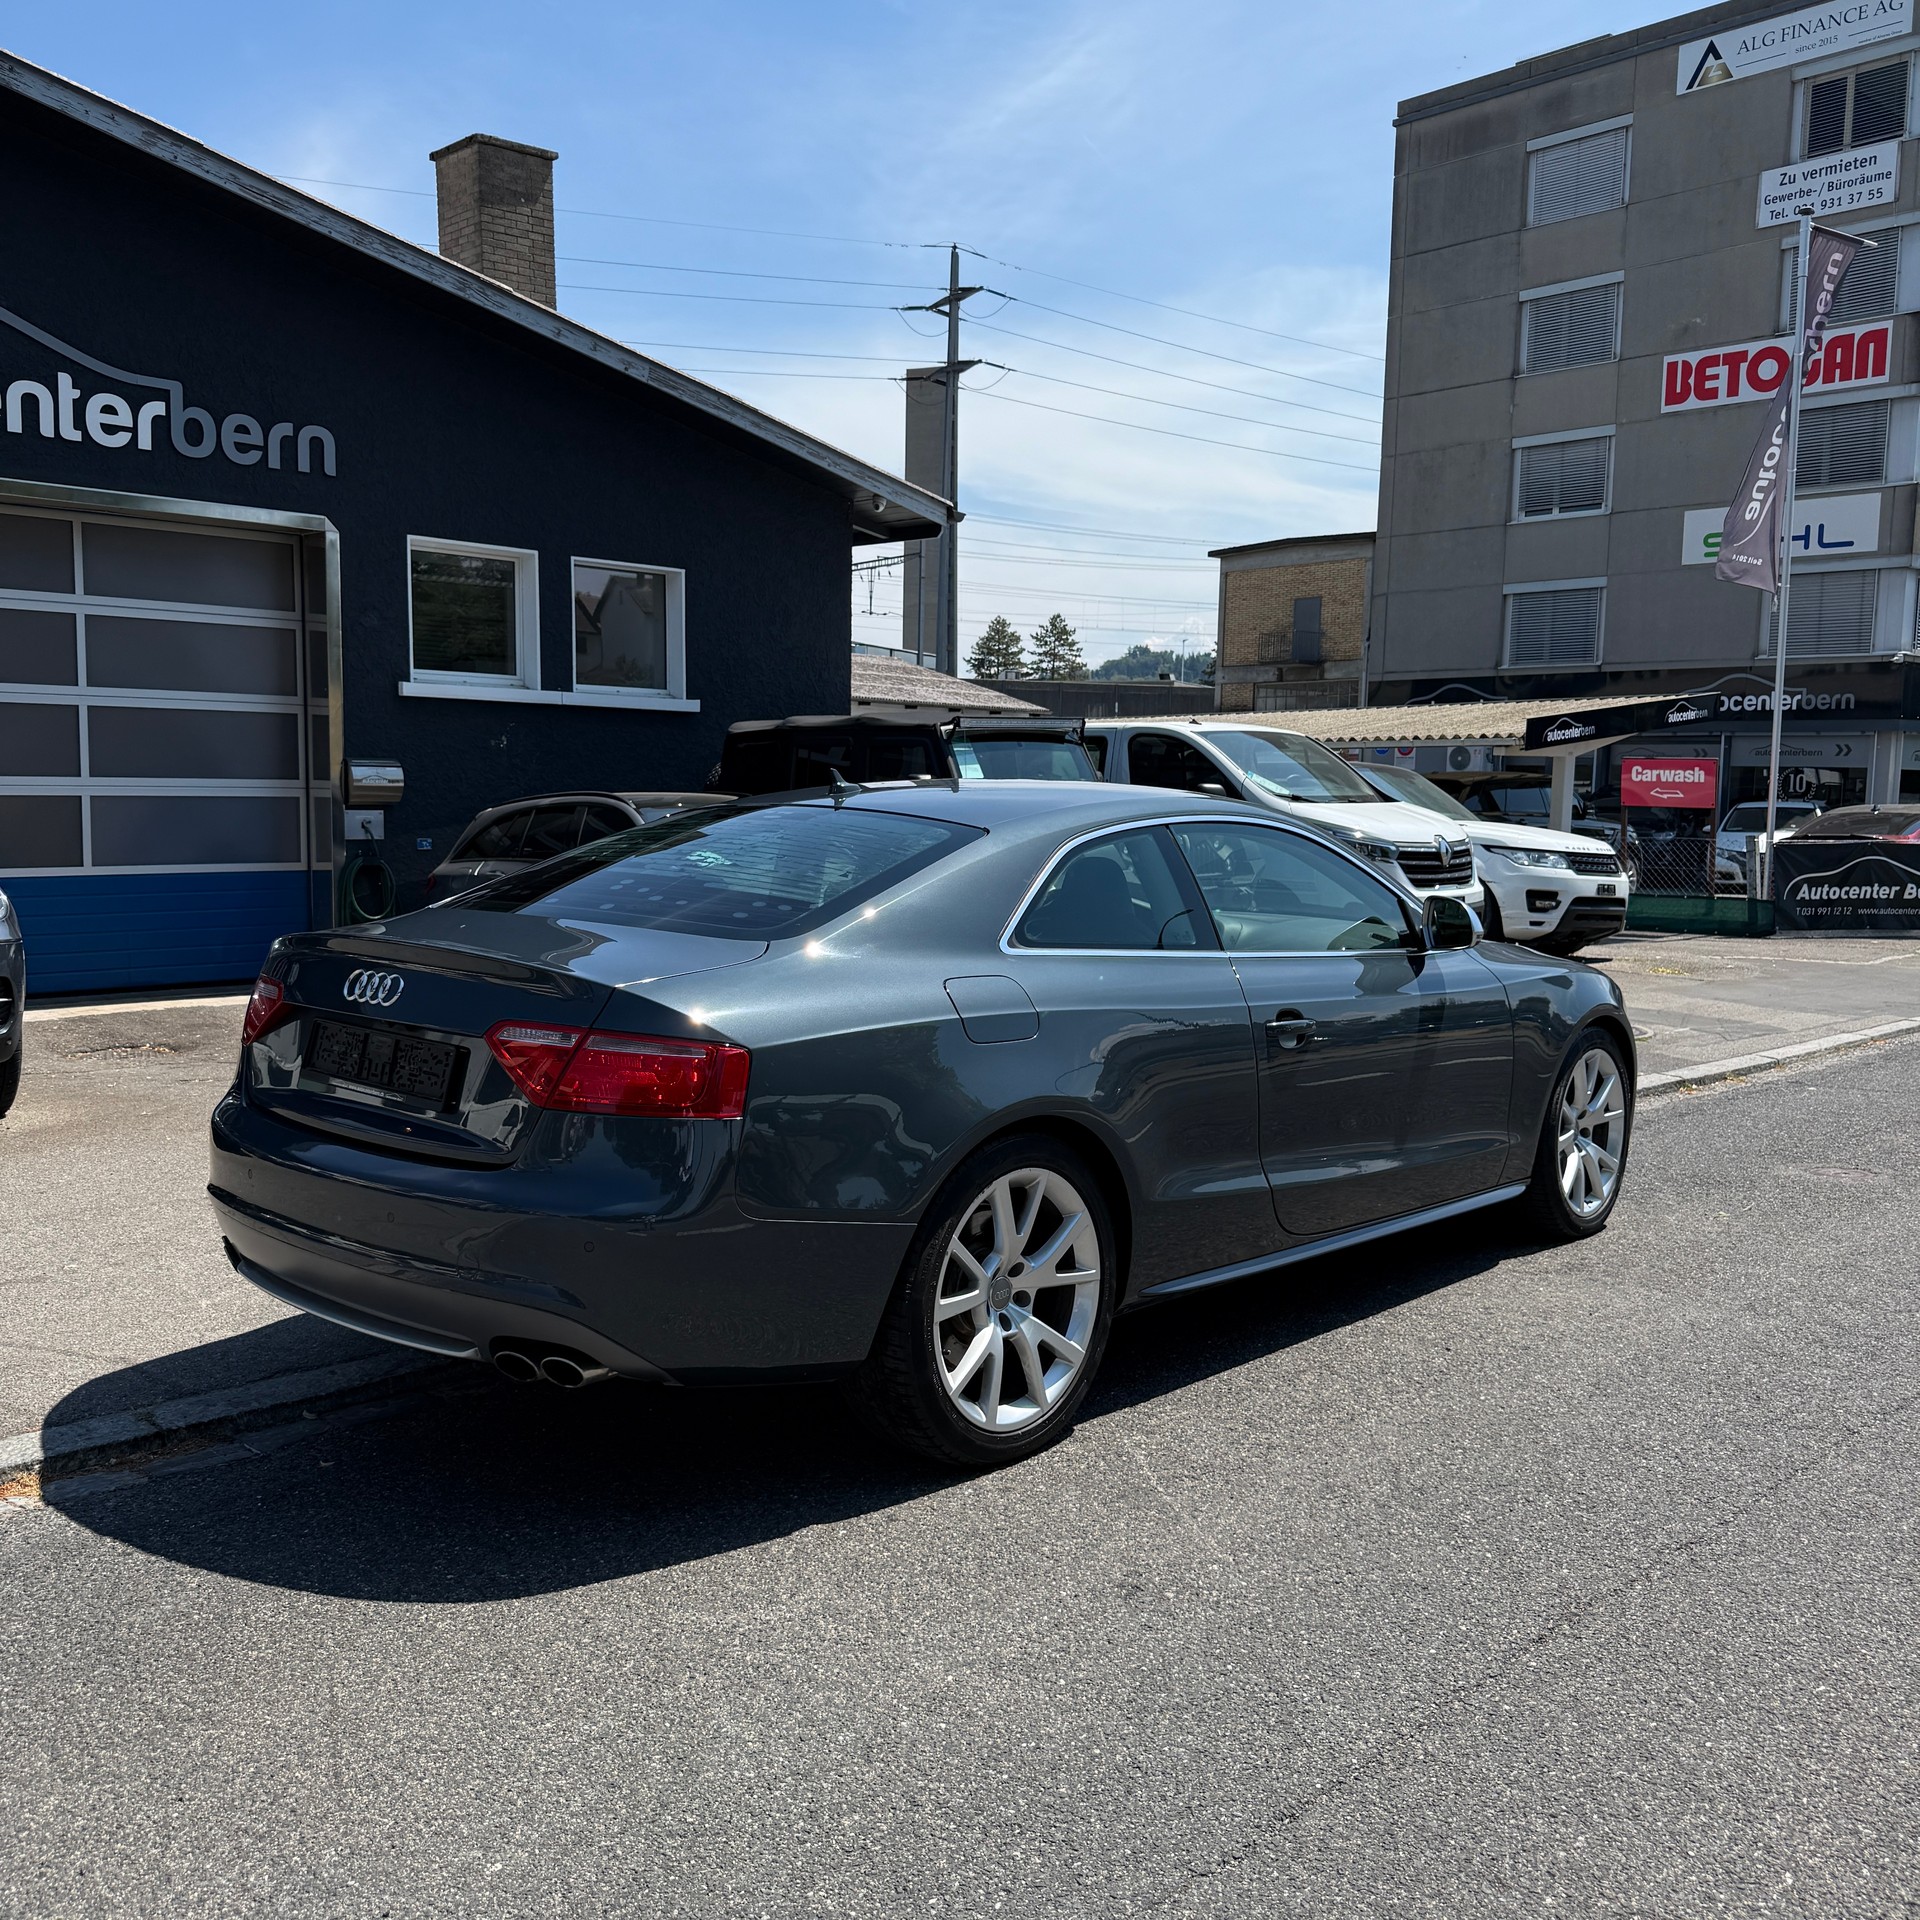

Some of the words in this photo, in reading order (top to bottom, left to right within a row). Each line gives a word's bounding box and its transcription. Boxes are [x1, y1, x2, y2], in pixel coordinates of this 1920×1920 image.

[1736, 31, 1775, 55] ALG
[1780, 4, 1869, 42] FINANCE
[1873, 0, 1904, 17] AG
[1795, 41, 1817, 54] since
[1818, 35, 1839, 48] 2015
[1779, 172, 1797, 187] Zu
[1802, 155, 1878, 181] vermieten
[1827, 170, 1893, 192] Büroräume
[1769, 207, 1789, 220] Tel.
[1793, 202, 1816, 216] 01
[1820, 196, 1843, 211] 931
[1847, 192, 1863, 205] 37
[1867, 187, 1884, 201] 55
[0, 372, 337, 477] nterbern
[1668, 708, 1709, 723] autocenterbern
[1546, 724, 1596, 742] autocenterbern
[1755, 748, 1823, 757] autoenterbern
[1631, 765, 1706, 783] Carwash
[1788, 773, 1807, 793] 10
[1796, 883, 1901, 900] Autocenter
[1903, 883, 1920, 900] B
[1801, 907, 1816, 916] 031
[1817, 907, 1831, 915] 991
[1833, 907, 1841, 915] 12
[1843, 906, 1853, 915] 12
